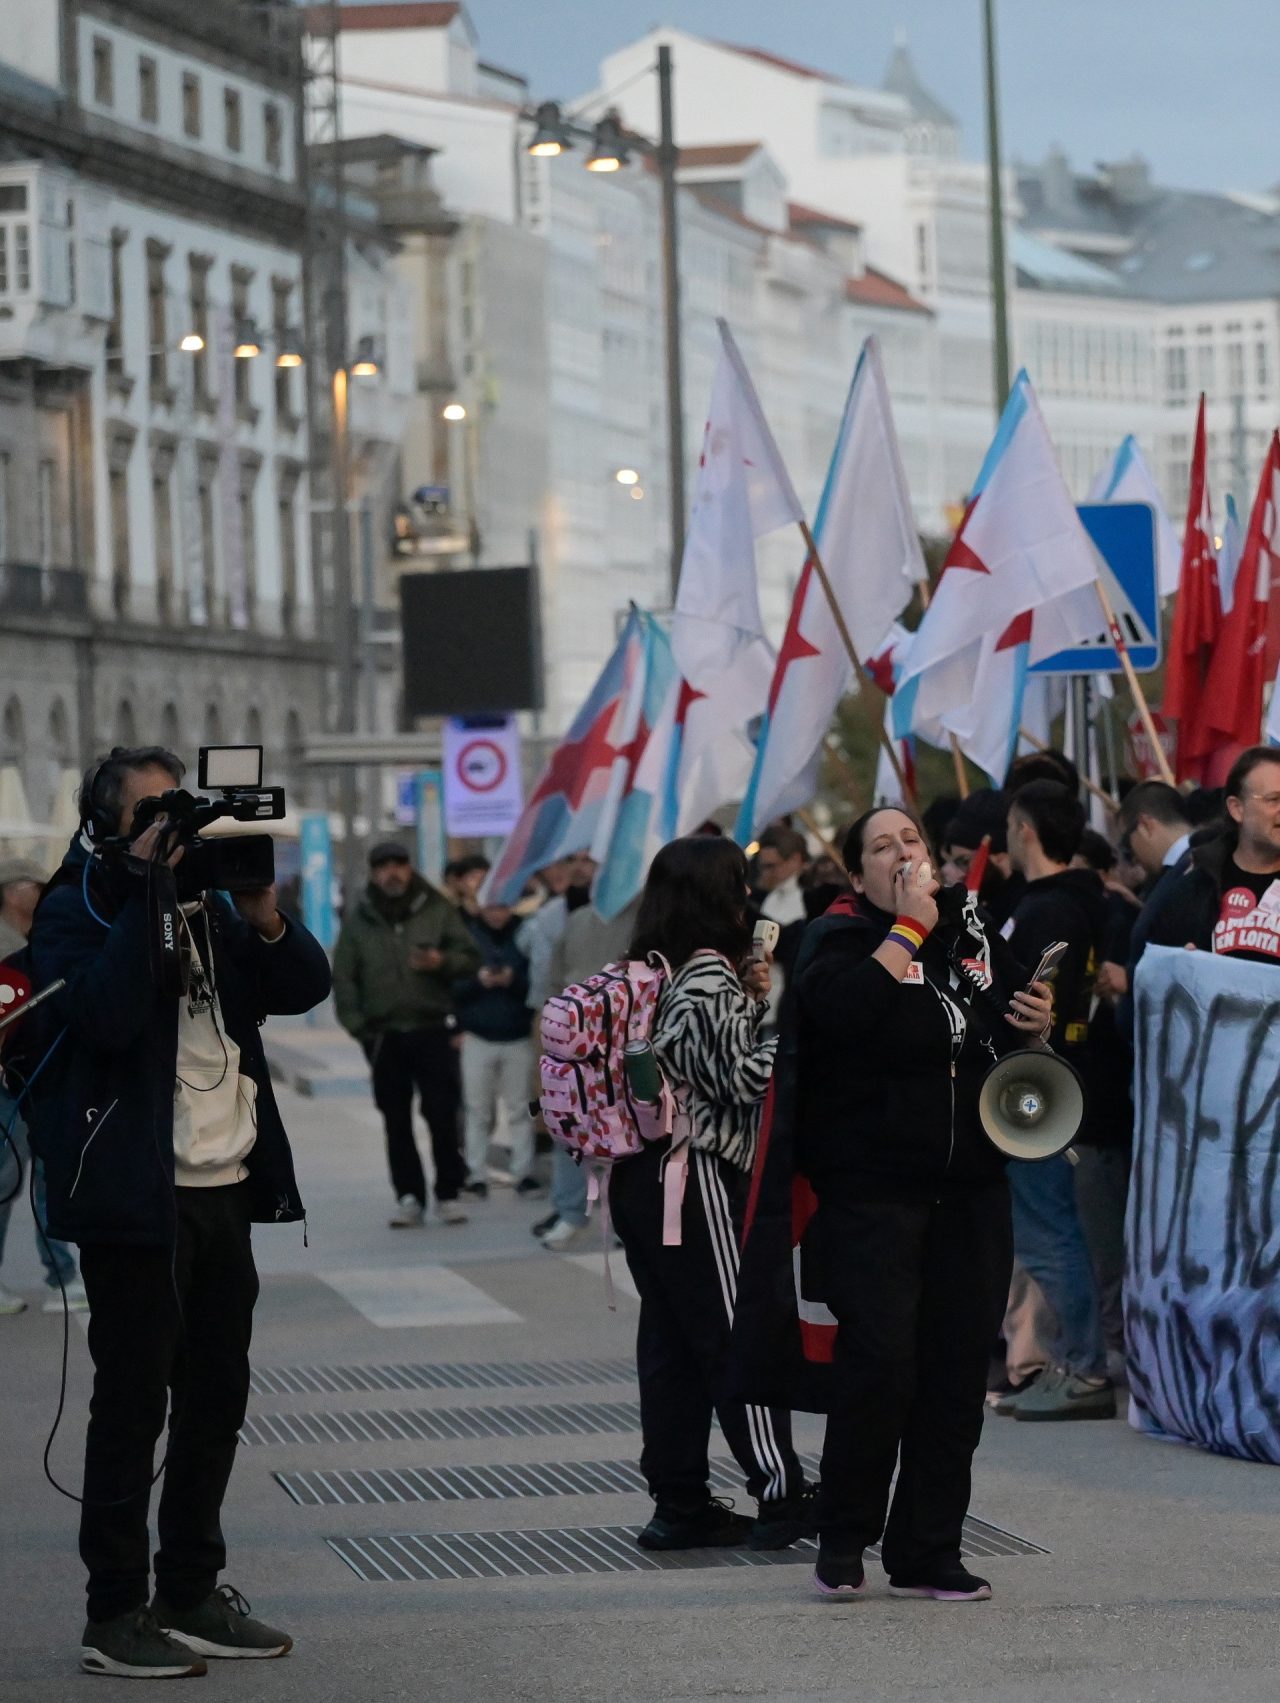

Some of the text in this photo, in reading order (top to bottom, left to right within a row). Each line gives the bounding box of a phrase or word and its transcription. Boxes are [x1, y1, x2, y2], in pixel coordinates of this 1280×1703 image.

[162, 913, 174, 951] SONY
[1214, 918, 1226, 934] O
[1215, 929, 1279, 953] EN LOITA
